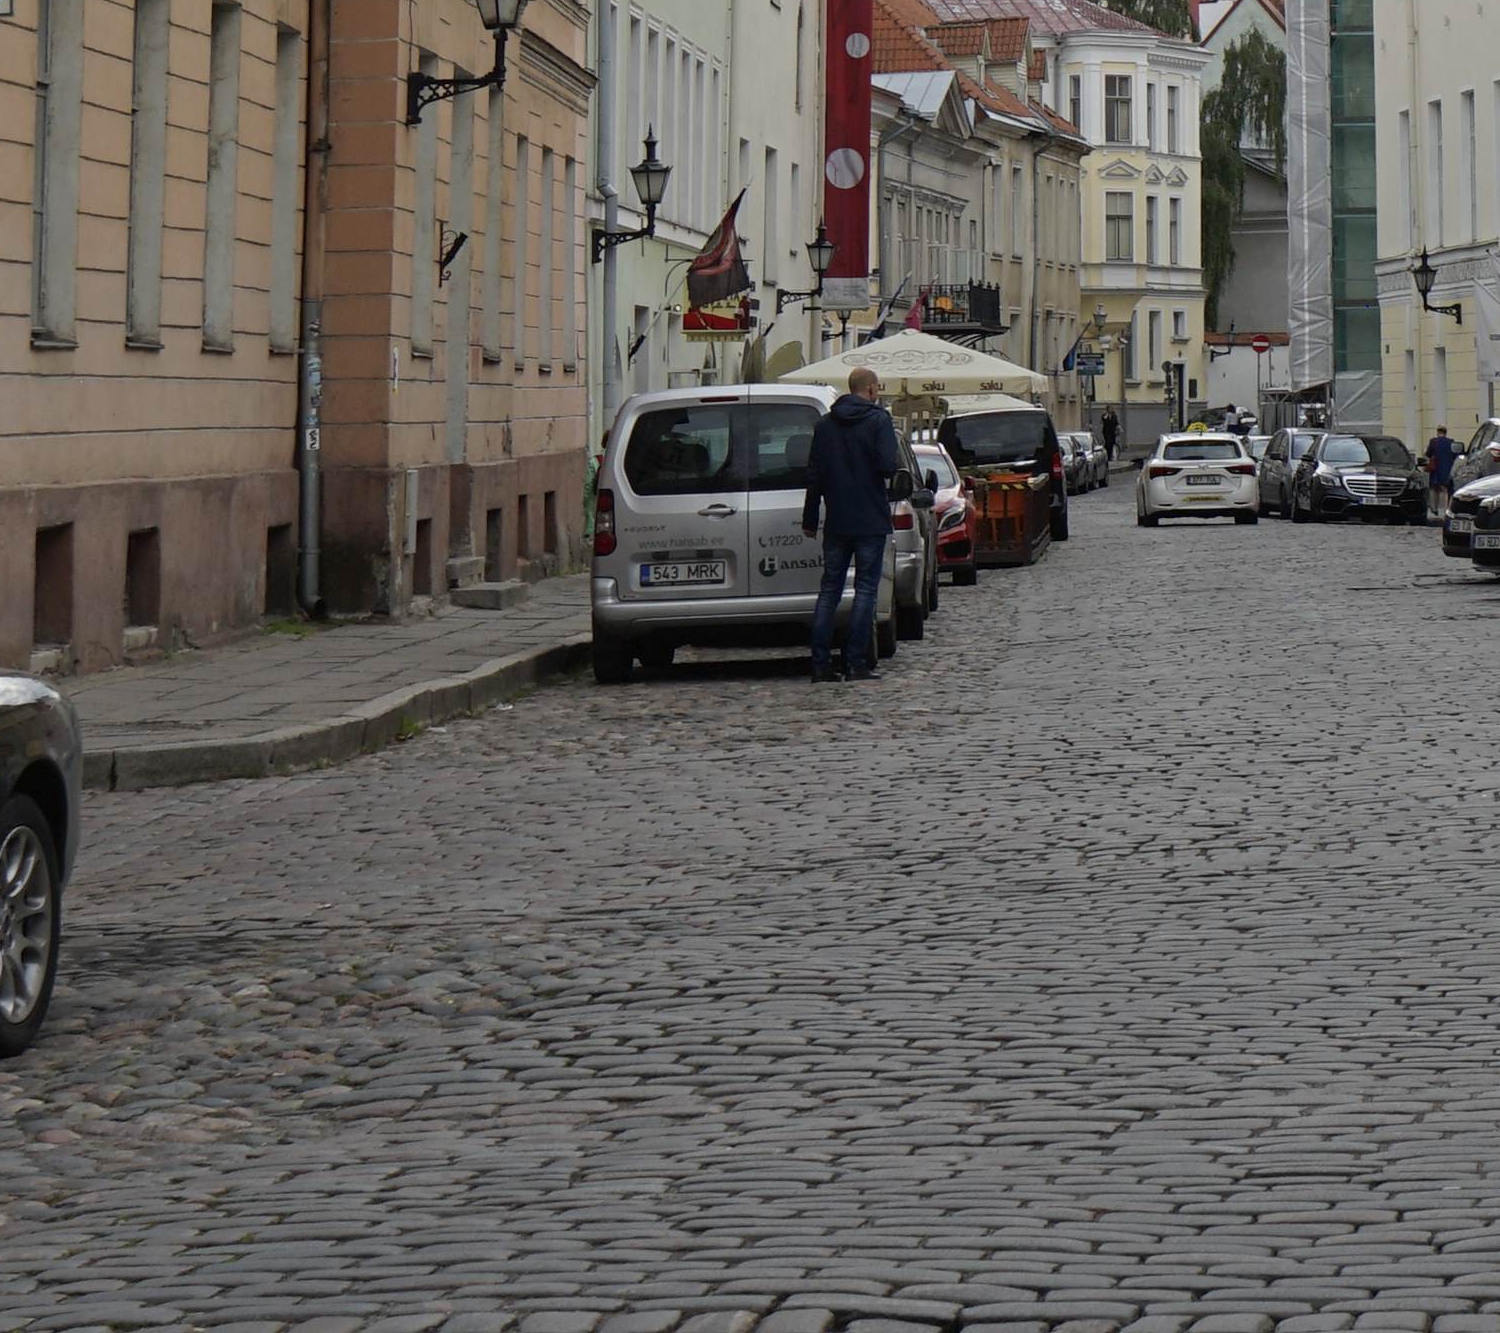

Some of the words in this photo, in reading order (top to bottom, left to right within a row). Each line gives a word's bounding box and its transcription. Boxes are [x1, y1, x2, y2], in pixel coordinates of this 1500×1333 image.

[922, 379, 945, 392] saku
[980, 379, 1003, 391] saku
[638, 535, 725, 550] www.hansab.ee
[769, 534, 803, 547] 17220
[653, 565, 678, 581] 543
[687, 563, 720, 579] MRK
